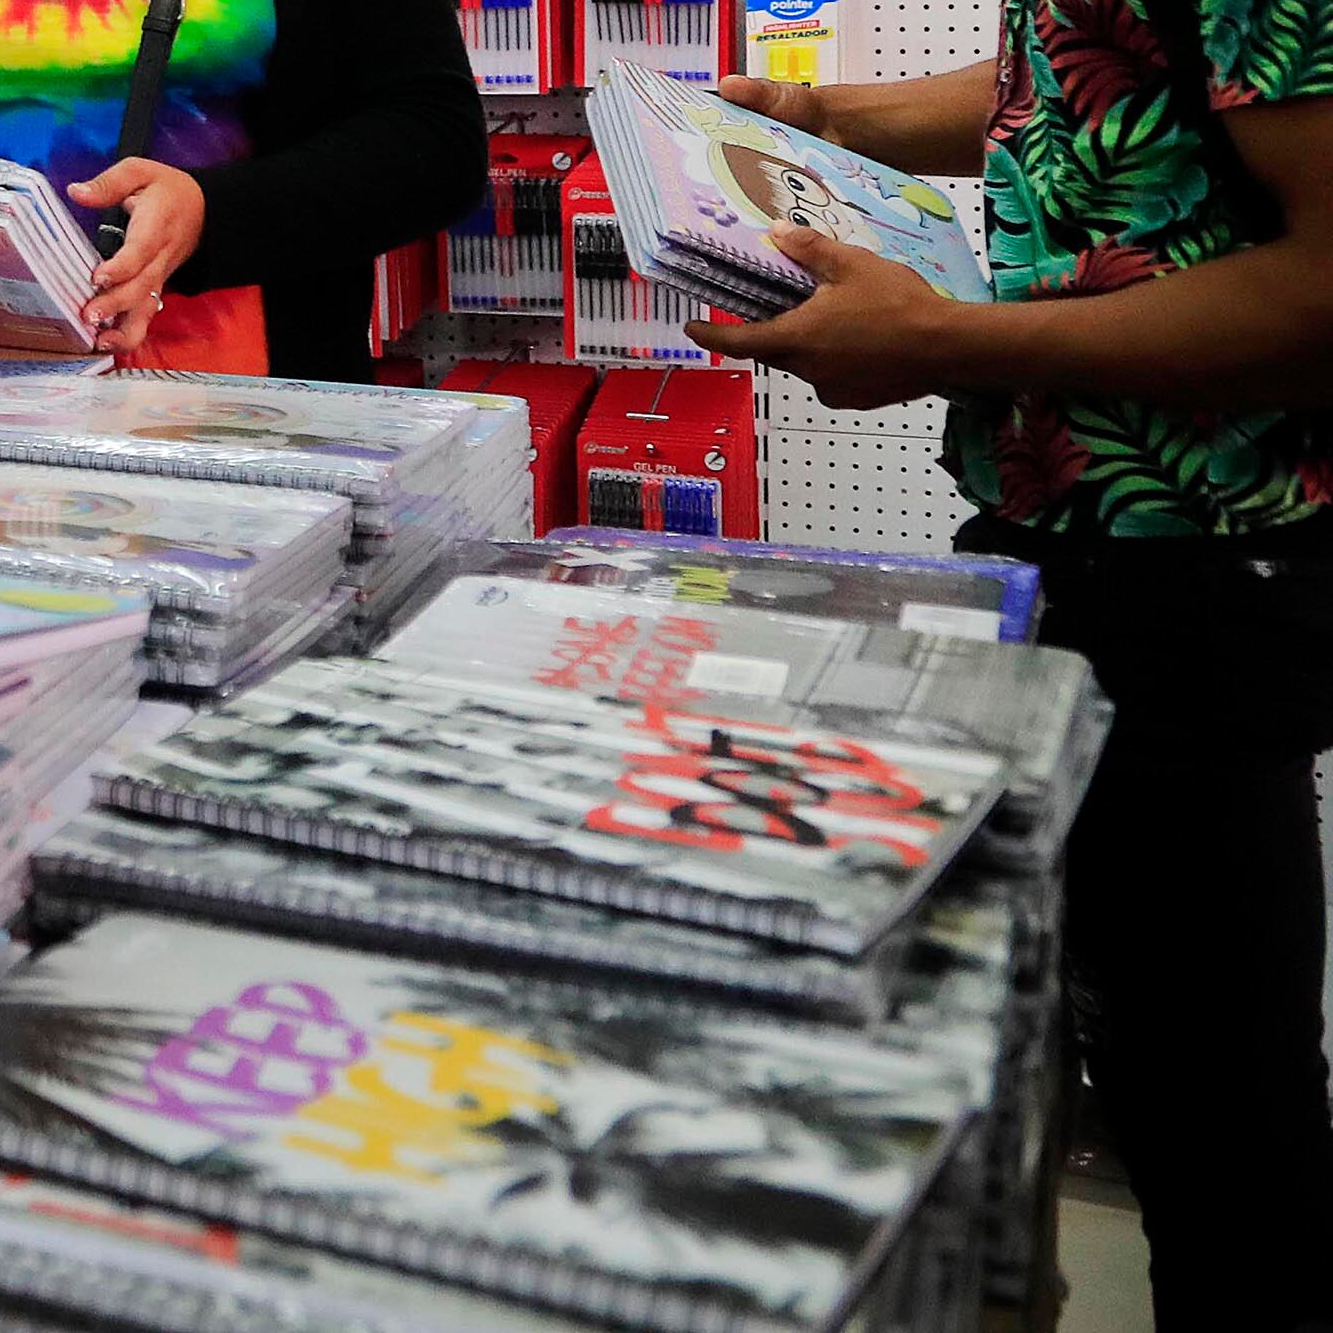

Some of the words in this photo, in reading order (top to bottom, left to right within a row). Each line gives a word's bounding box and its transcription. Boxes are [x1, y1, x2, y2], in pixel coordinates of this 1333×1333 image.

[770, 0, 813, 11] pointer
[757, 29, 828, 42] RESALTADOR
[633, 462, 653, 473] GEL
[655, 464, 677, 474] PEN
[106, 981, 369, 1141] KEEP
